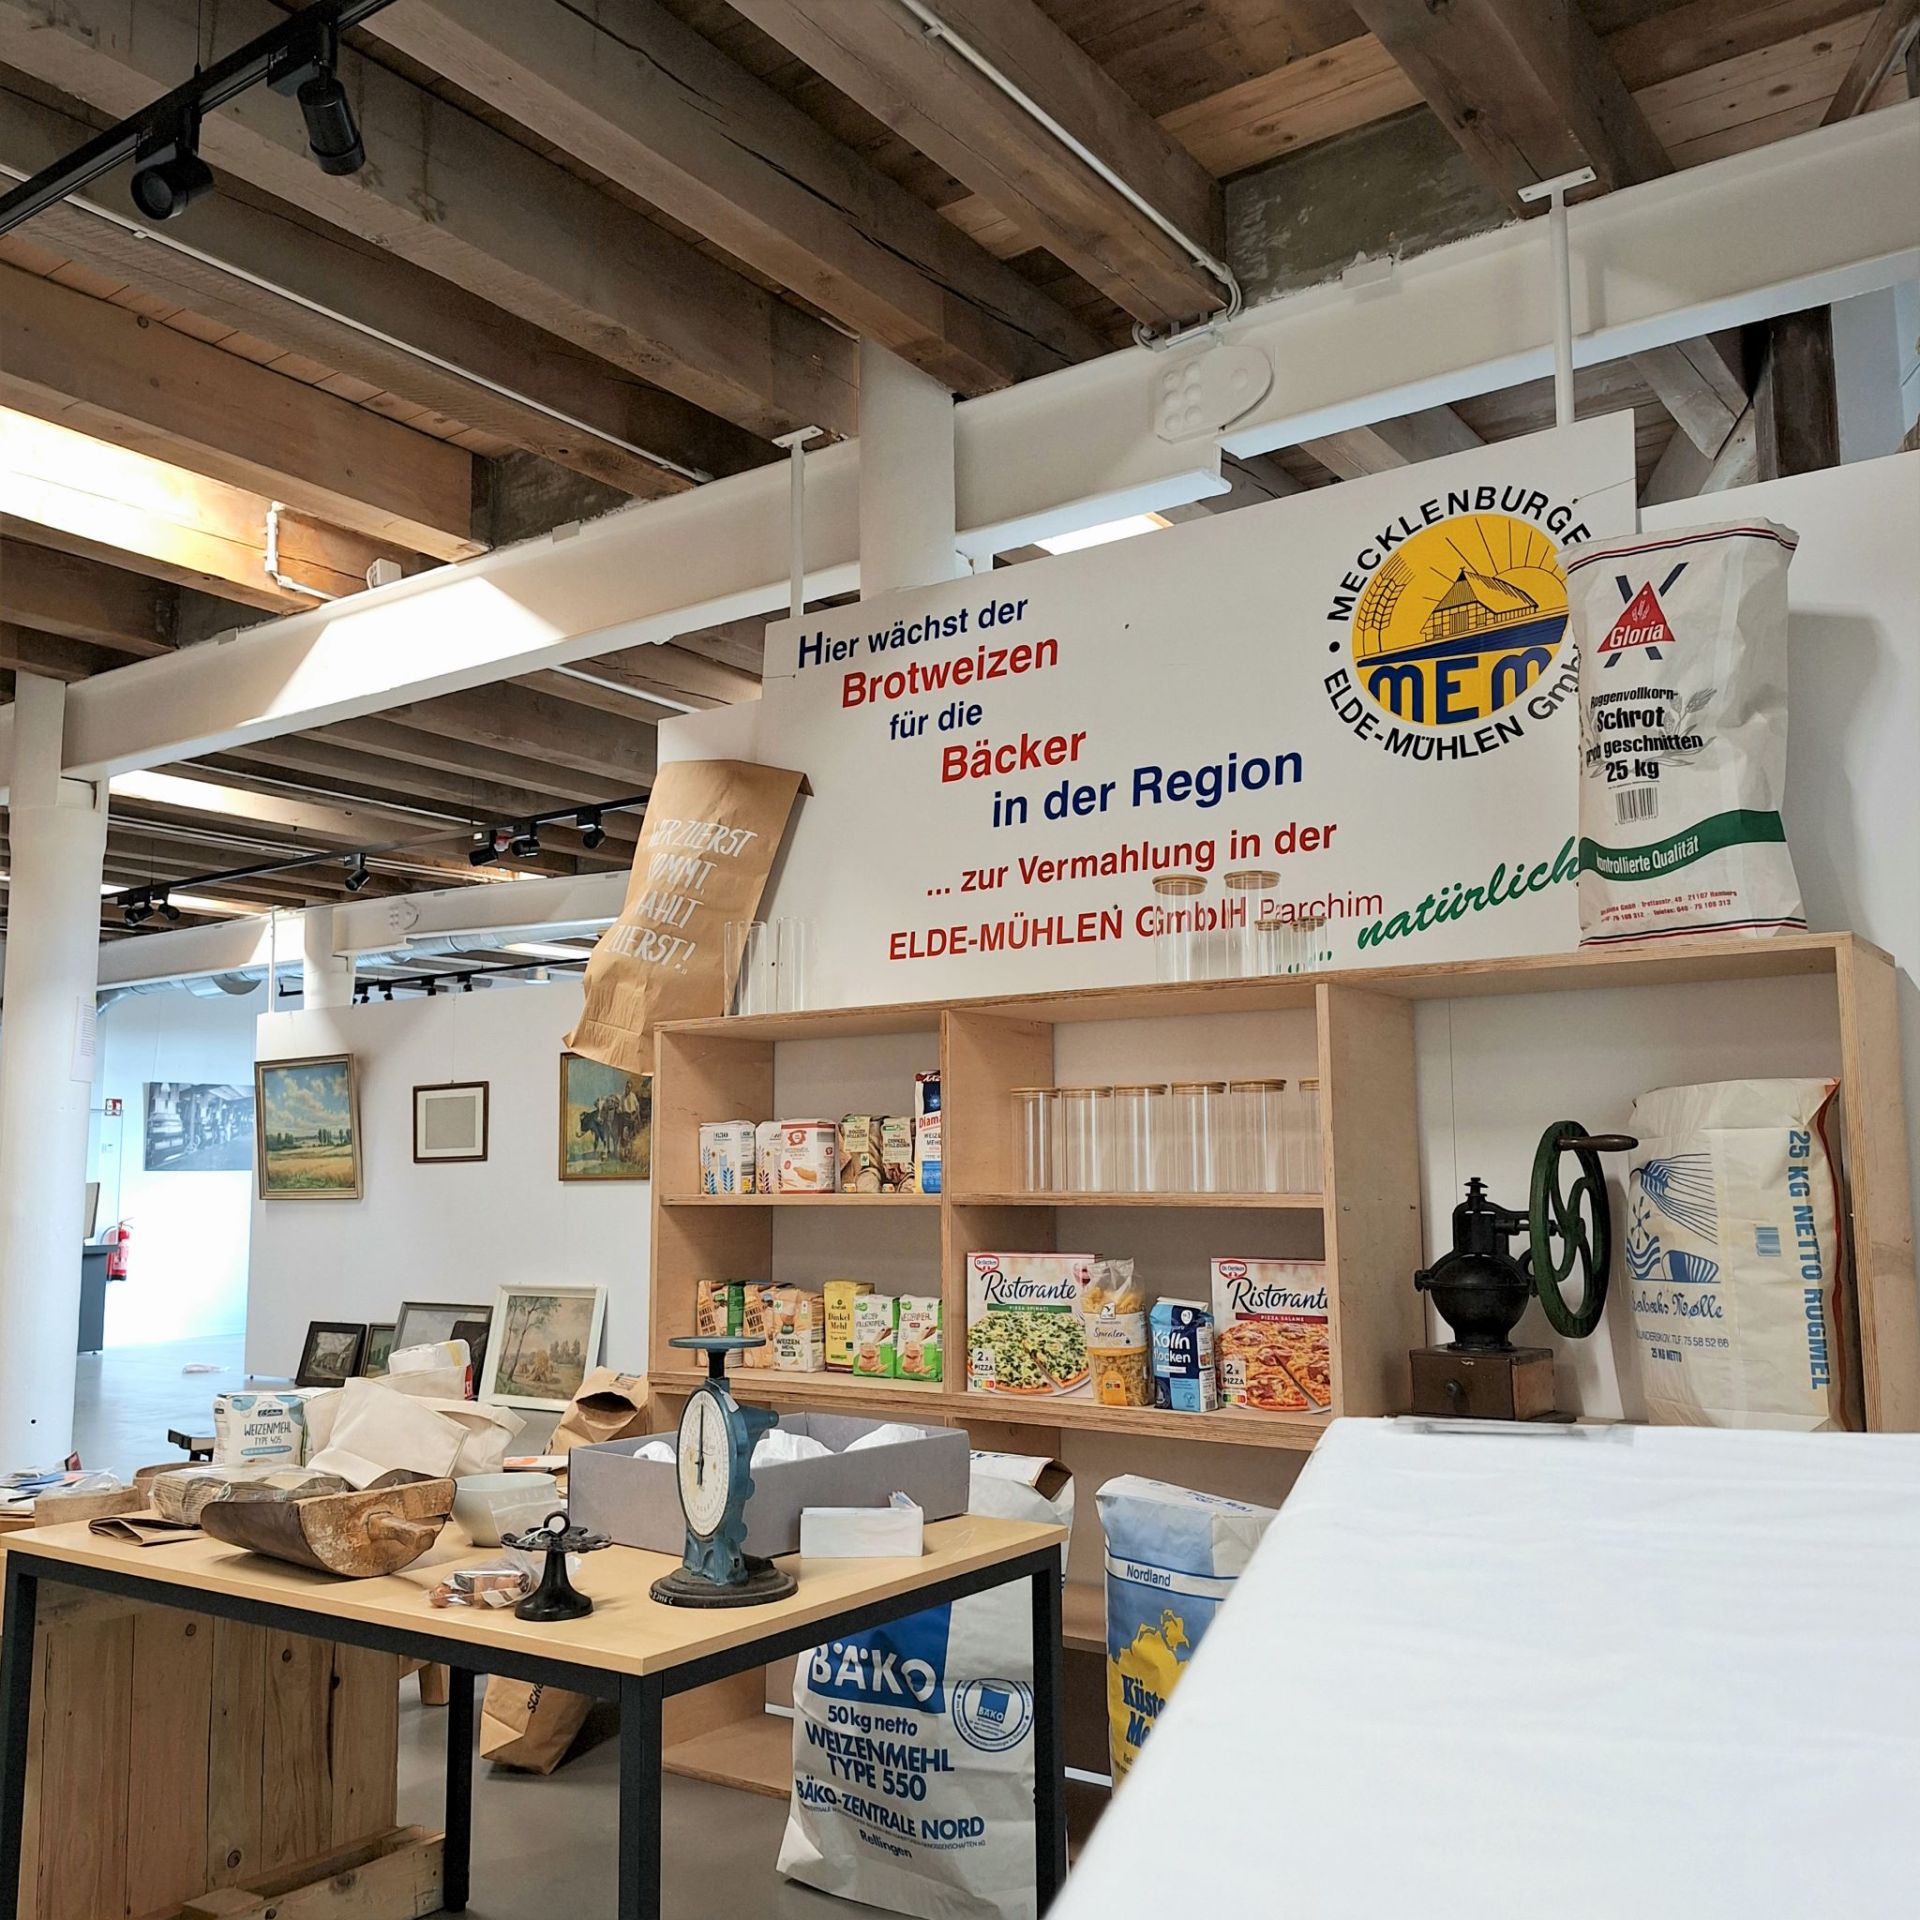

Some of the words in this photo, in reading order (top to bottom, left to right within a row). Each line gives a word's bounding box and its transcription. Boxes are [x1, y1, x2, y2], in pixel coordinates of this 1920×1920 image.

[1327, 485, 1591, 621] MECKLENBURGE
[797, 633, 860, 669] Hier
[867, 608, 968, 656] wächst
[977, 596, 1029, 630] der
[1609, 620, 1665, 649] Gloria
[842, 637, 1059, 709] Brotweizen
[889, 708, 928, 742] für
[938, 702, 984, 733] die
[1324, 668, 1525, 761] ELDE-MÜHLEN
[1527, 644, 1580, 721] Gmb
[1596, 706, 1665, 732] Schrot
[940, 730, 1088, 784] Bäcker
[1603, 734, 1704, 759] geschnitten
[992, 791, 1029, 829] in
[1043, 780, 1117, 822] der
[1131, 750, 1305, 811] Region
[1605, 759, 1629, 783] 25
[1634, 758, 1660, 780] kg
[672, 820, 759, 858] ZUERST
[959, 863, 1010, 894] zur
[1017, 835, 1216, 886] Vermahlung
[1229, 829, 1262, 861] in
[1273, 822, 1338, 856] der
[1651, 834, 1700, 869] Qualität
[646, 852, 718, 896] OMMT,
[1356, 835, 1579, 950] natürlich
[633, 889, 705, 929] AHLT
[888, 909, 1124, 962] ELDE-MÜHLEN
[919, 1115, 941, 1129] Diam
[1788, 1130, 1811, 1158] 25
[1788, 1166, 1811, 1198] KG
[1792, 1205, 1824, 1281] NETTO
[980, 1269, 1077, 1305] Ristorante
[1152, 1329, 1191, 1350] Kölln
[1803, 1287, 1831, 1390] RUGMEL
[244, 1420, 292, 1436] WEIZENMEHL
[1126, 1563, 1171, 1587] Nordland
[811, 1641, 937, 1703] BÄKO
[1120, 1673, 1167, 1719] Küste
[827, 1704, 848, 1725] 50
[849, 1706, 871, 1733] kg
[874, 1714, 918, 1737] netto
[804, 1720, 955, 1773] WEIZENMEHL
[827, 1753, 876, 1790] TYPE
[882, 1771, 927, 1802] 550
[795, 1776, 917, 1838] BÄKO-ZENTRALE
[921, 1815, 985, 1840] NORD
[858, 1828, 913, 1859] Rellingen
